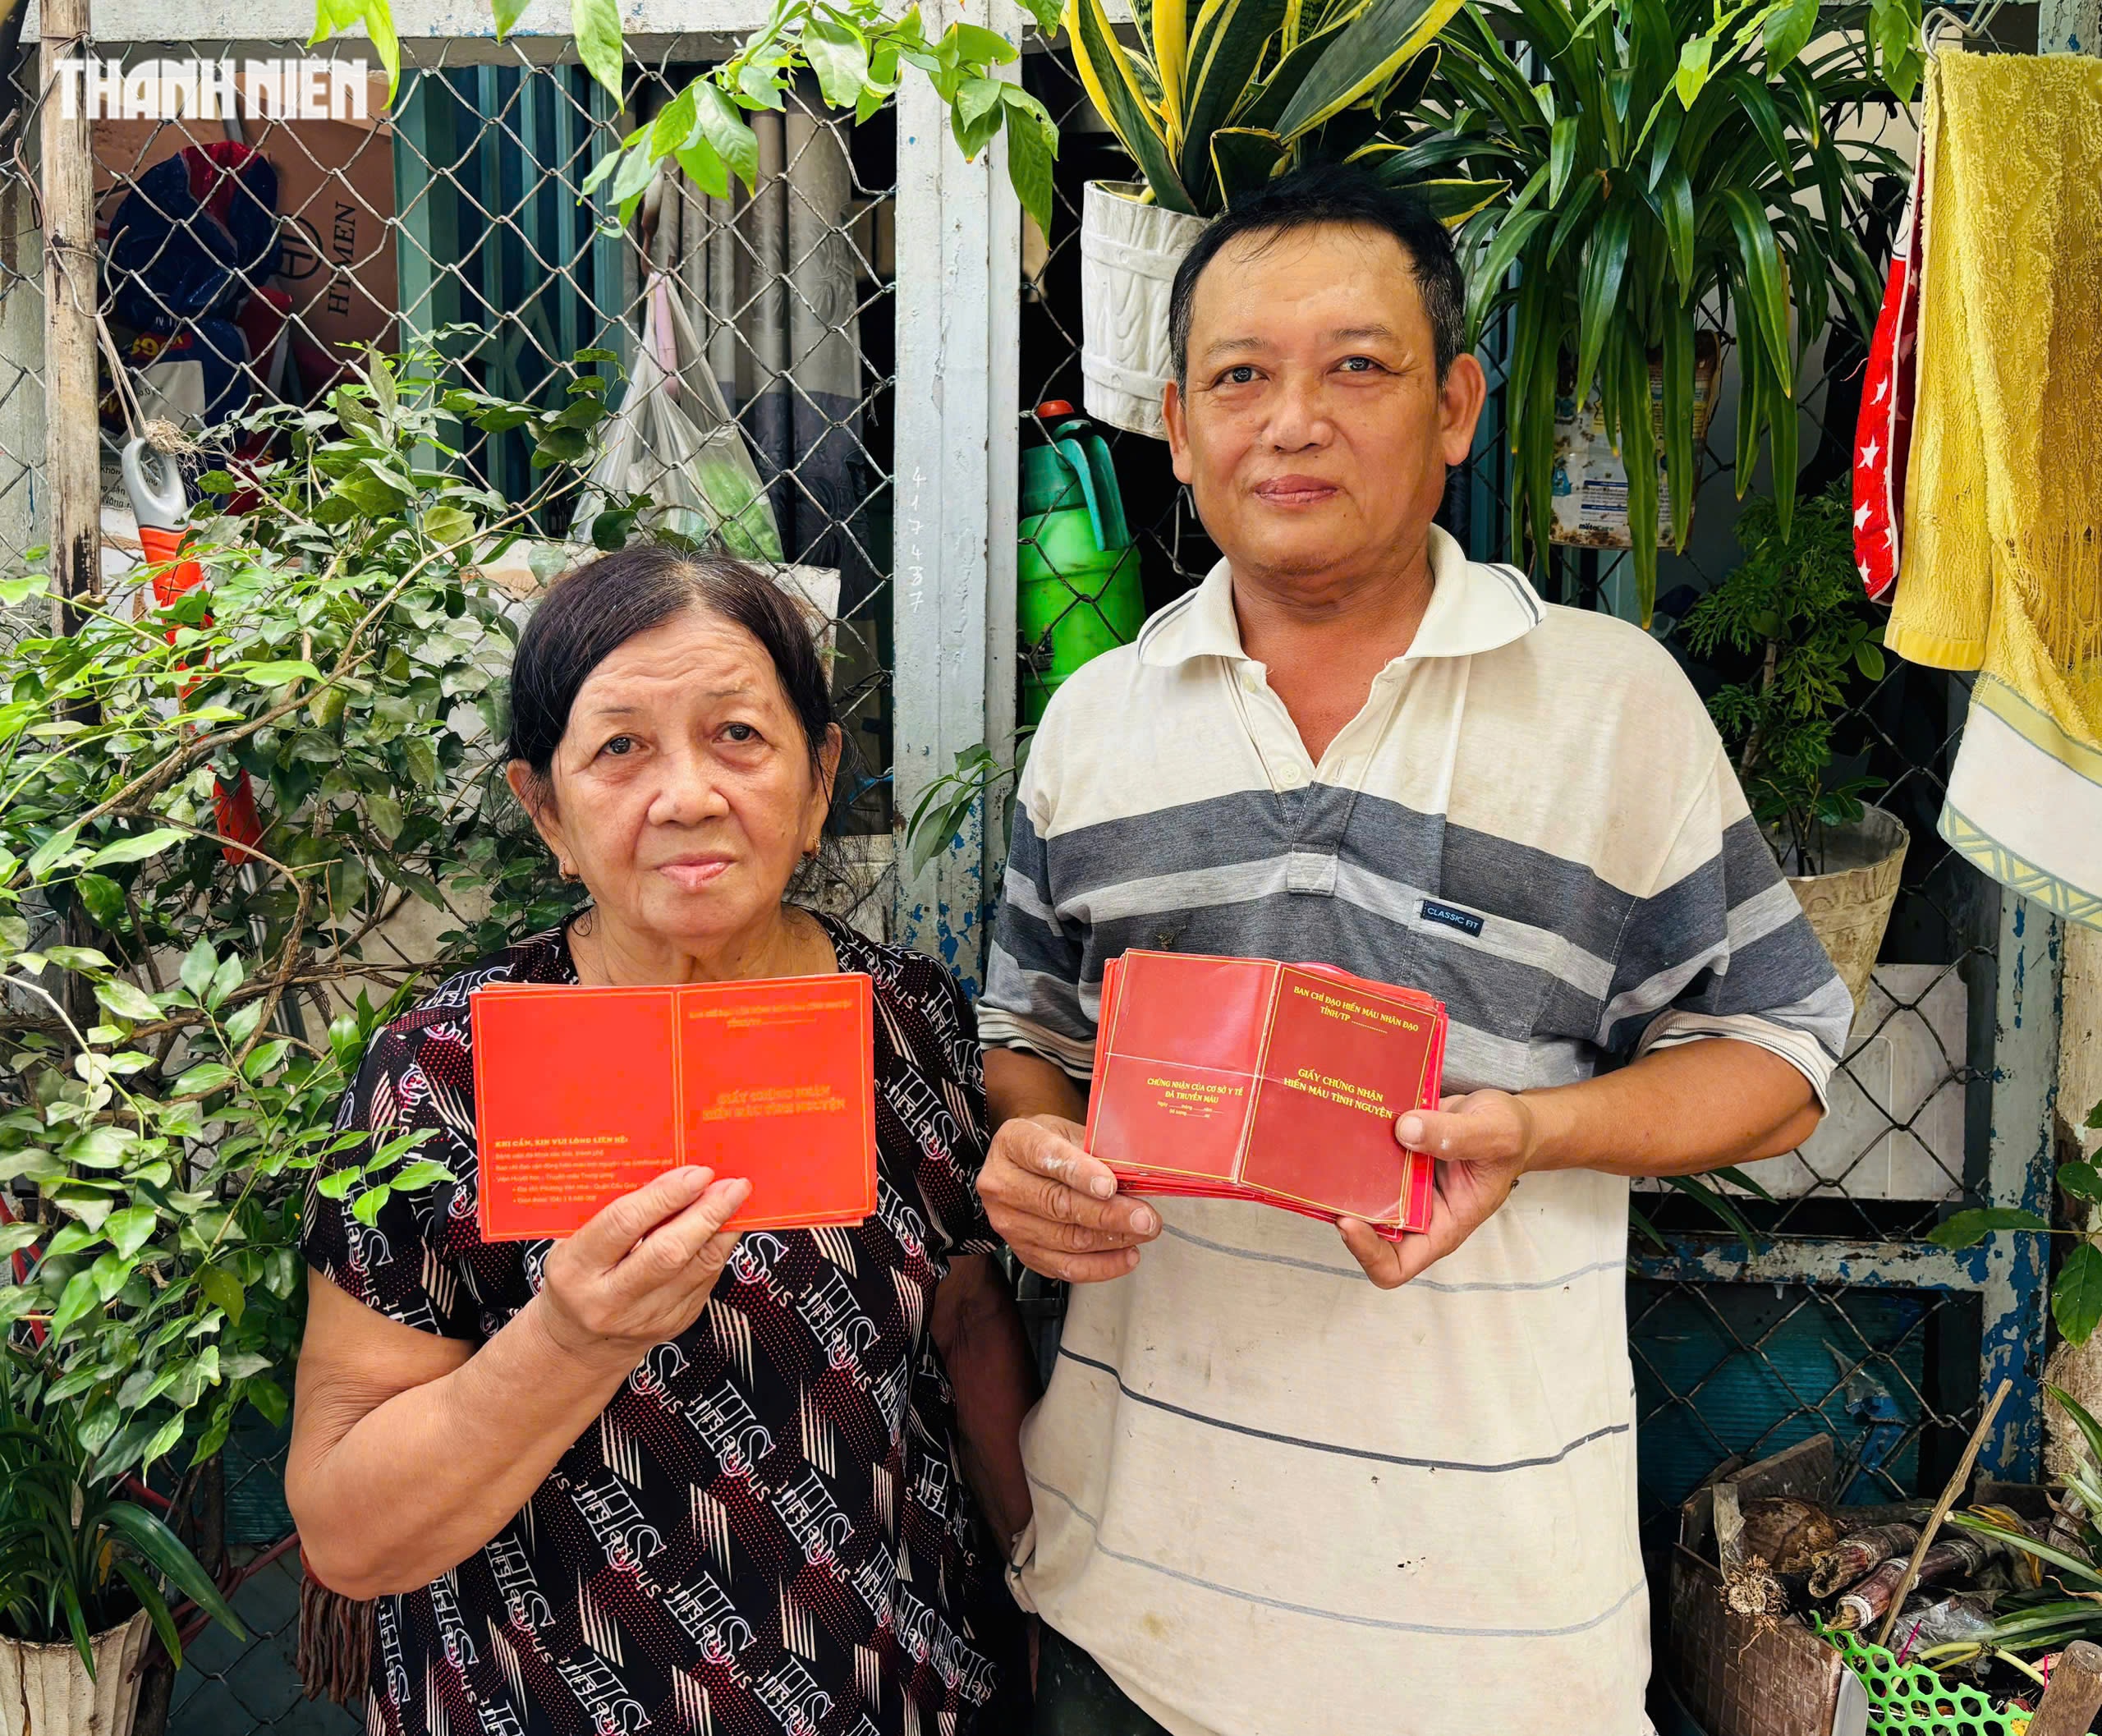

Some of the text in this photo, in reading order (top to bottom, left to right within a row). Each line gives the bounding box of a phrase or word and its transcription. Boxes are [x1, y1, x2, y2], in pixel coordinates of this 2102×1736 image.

[1427, 907, 1479, 930] CLASSIC FIT
[1293, 986, 1310, 997] BAN
[1325, 996, 1342, 1008] ĐẠO
[1342, 1001, 1361, 1013] HIẾN
[1361, 1008, 1379, 1019] MÁU
[1402, 1021, 1419, 1032] ĐẠO
[1147, 1077, 1171, 1087] CHỨNG
[1172, 1081, 1190, 1091] NHẬN
[1283, 1077, 1393, 1119] HIẾN MÁU TÌNH NGUYỆN
[1298, 1068, 1384, 1103] GIẤY CHỨNG NHẬN
